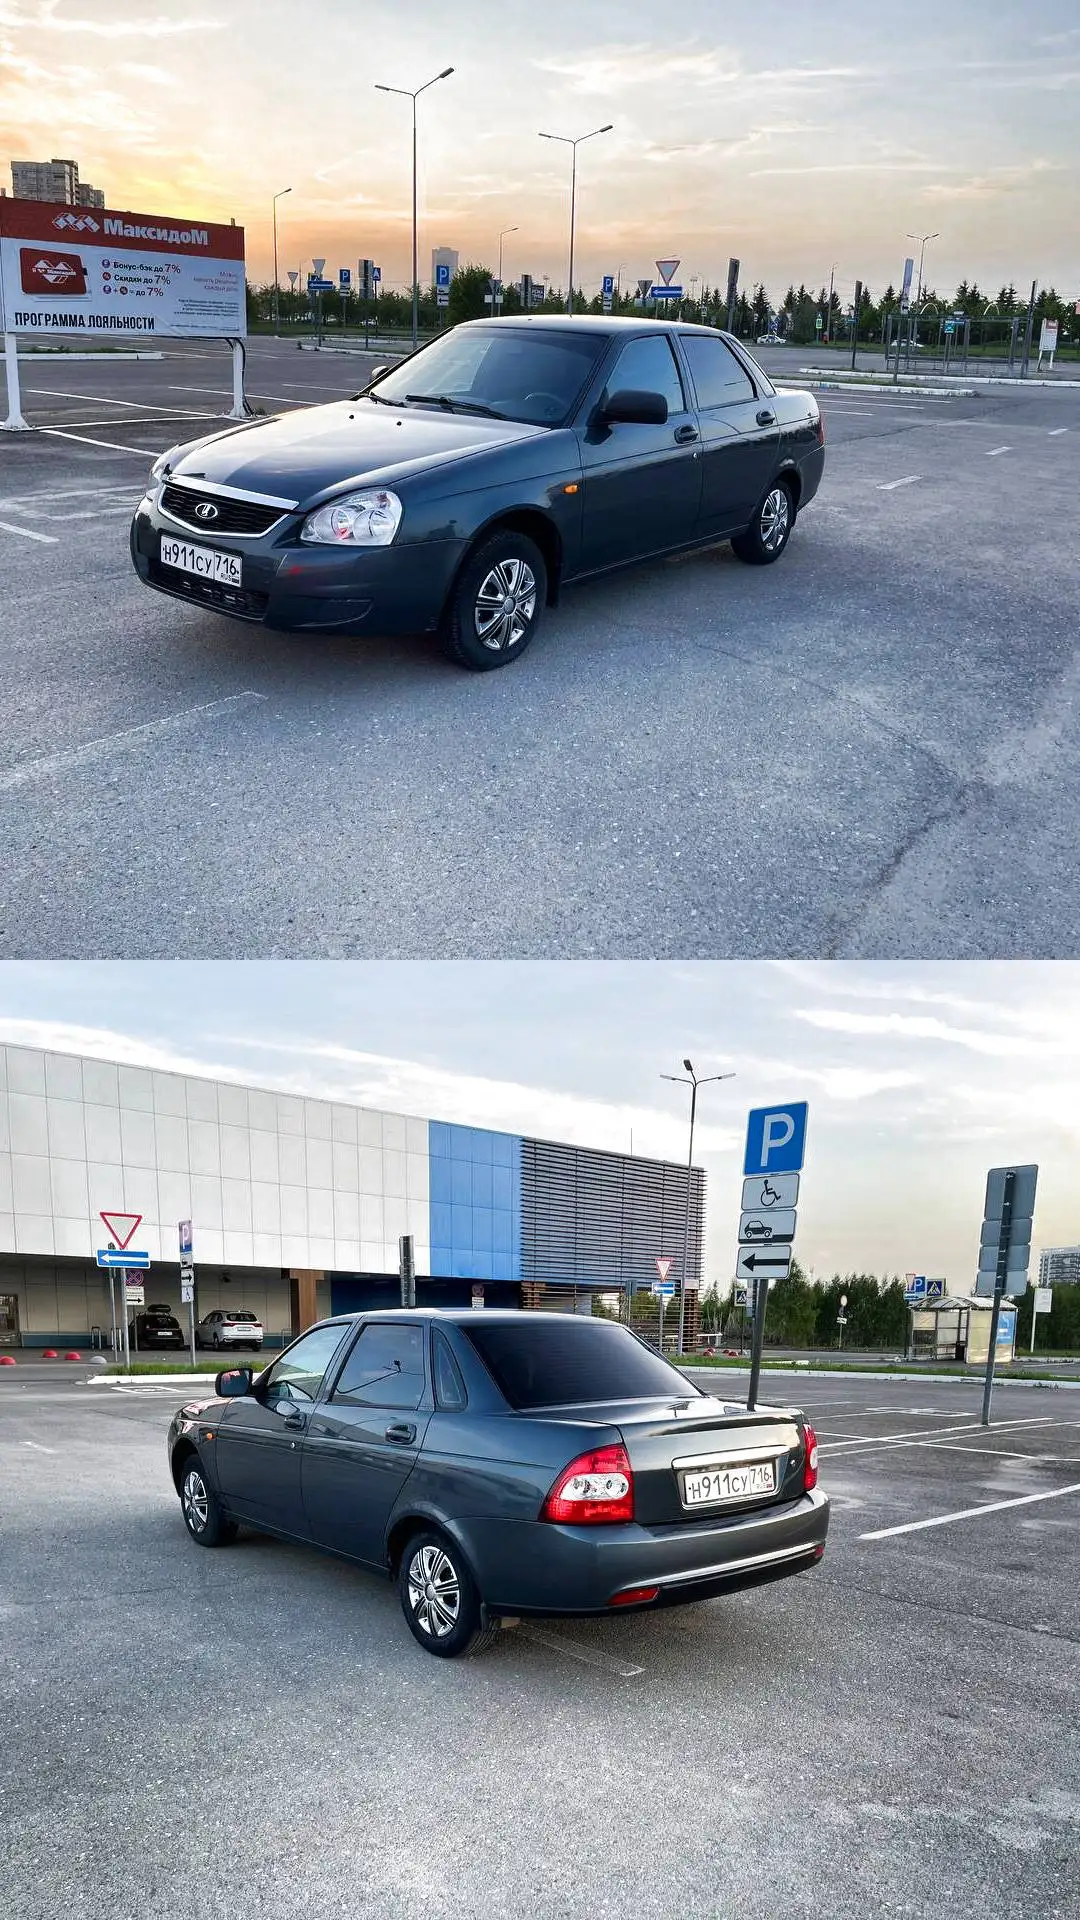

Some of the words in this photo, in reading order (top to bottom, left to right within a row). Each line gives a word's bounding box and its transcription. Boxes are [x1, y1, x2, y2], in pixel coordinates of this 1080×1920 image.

[113, 261, 153, 273] Бонус-бэк
[154, 266, 163, 274] до
[164, 264, 181, 274] 7%
[114, 274, 142, 283] Скидки
[154, 275, 171, 285] 7%
[147, 287, 164, 297] 7%
[14, 312, 86, 328] ПРОГРАММА
[87, 315, 155, 330] ЛОЯЛЬНОСТИ
[760, 1112, 795, 1167] P
